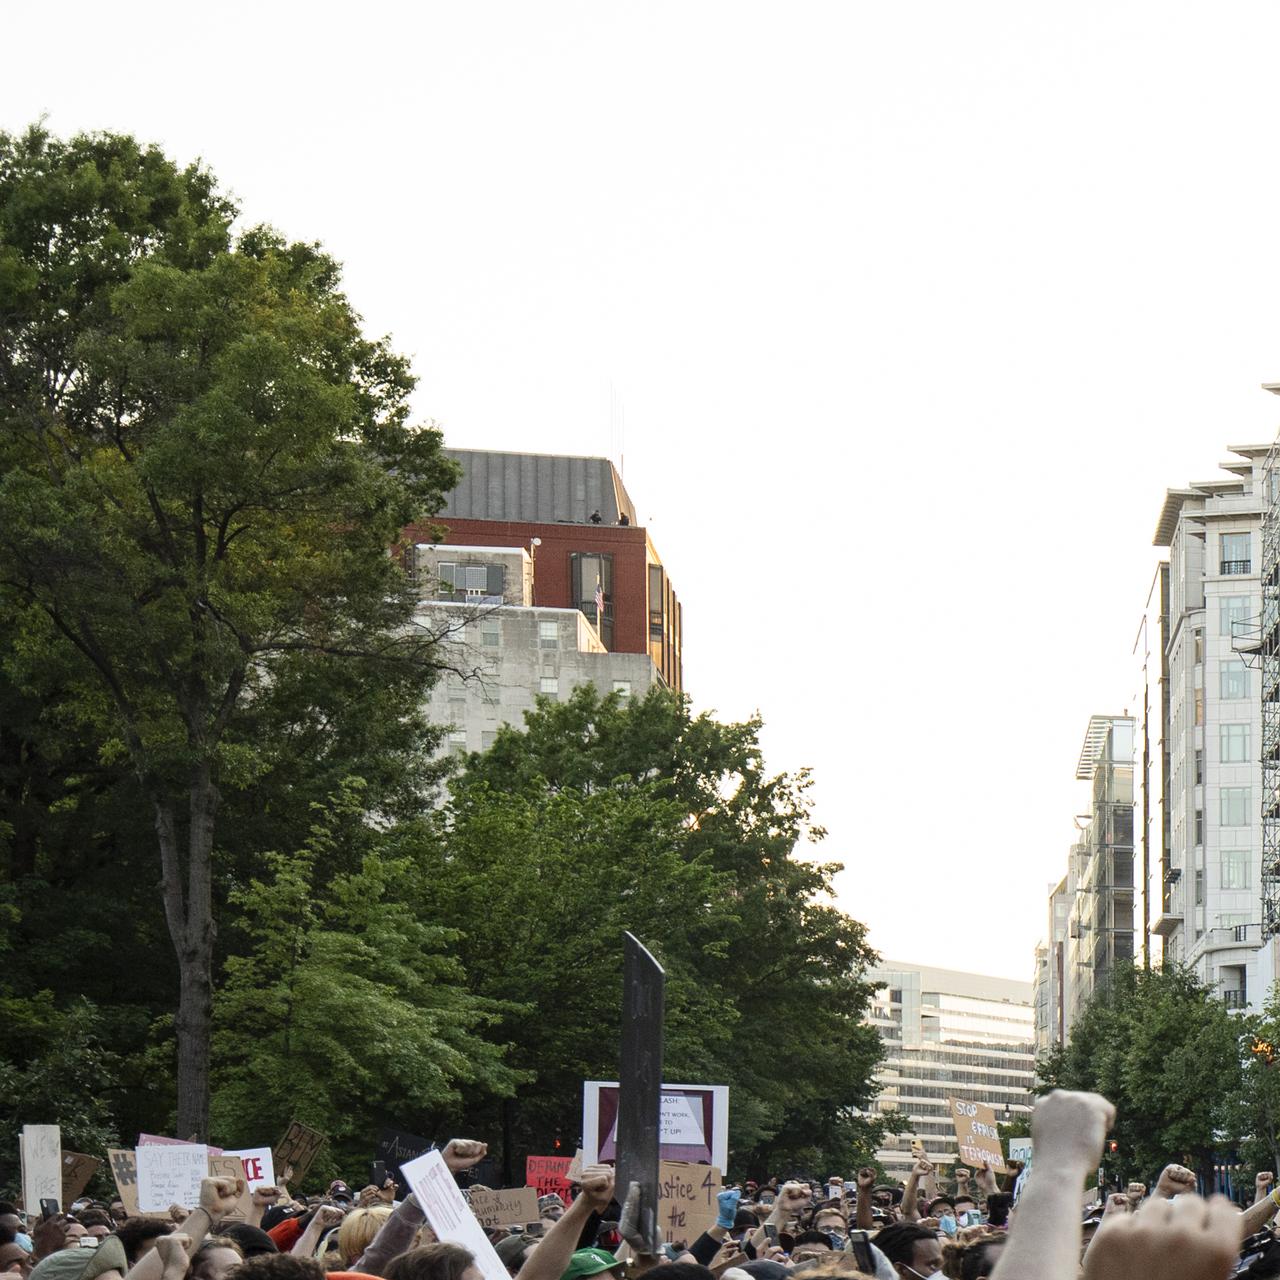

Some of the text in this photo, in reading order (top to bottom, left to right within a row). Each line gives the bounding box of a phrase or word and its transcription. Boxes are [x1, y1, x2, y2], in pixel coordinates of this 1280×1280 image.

[955, 1101, 978, 1117] STOP
[701, 1171, 716, 1205] 4
[667, 1206, 687, 1228] the
